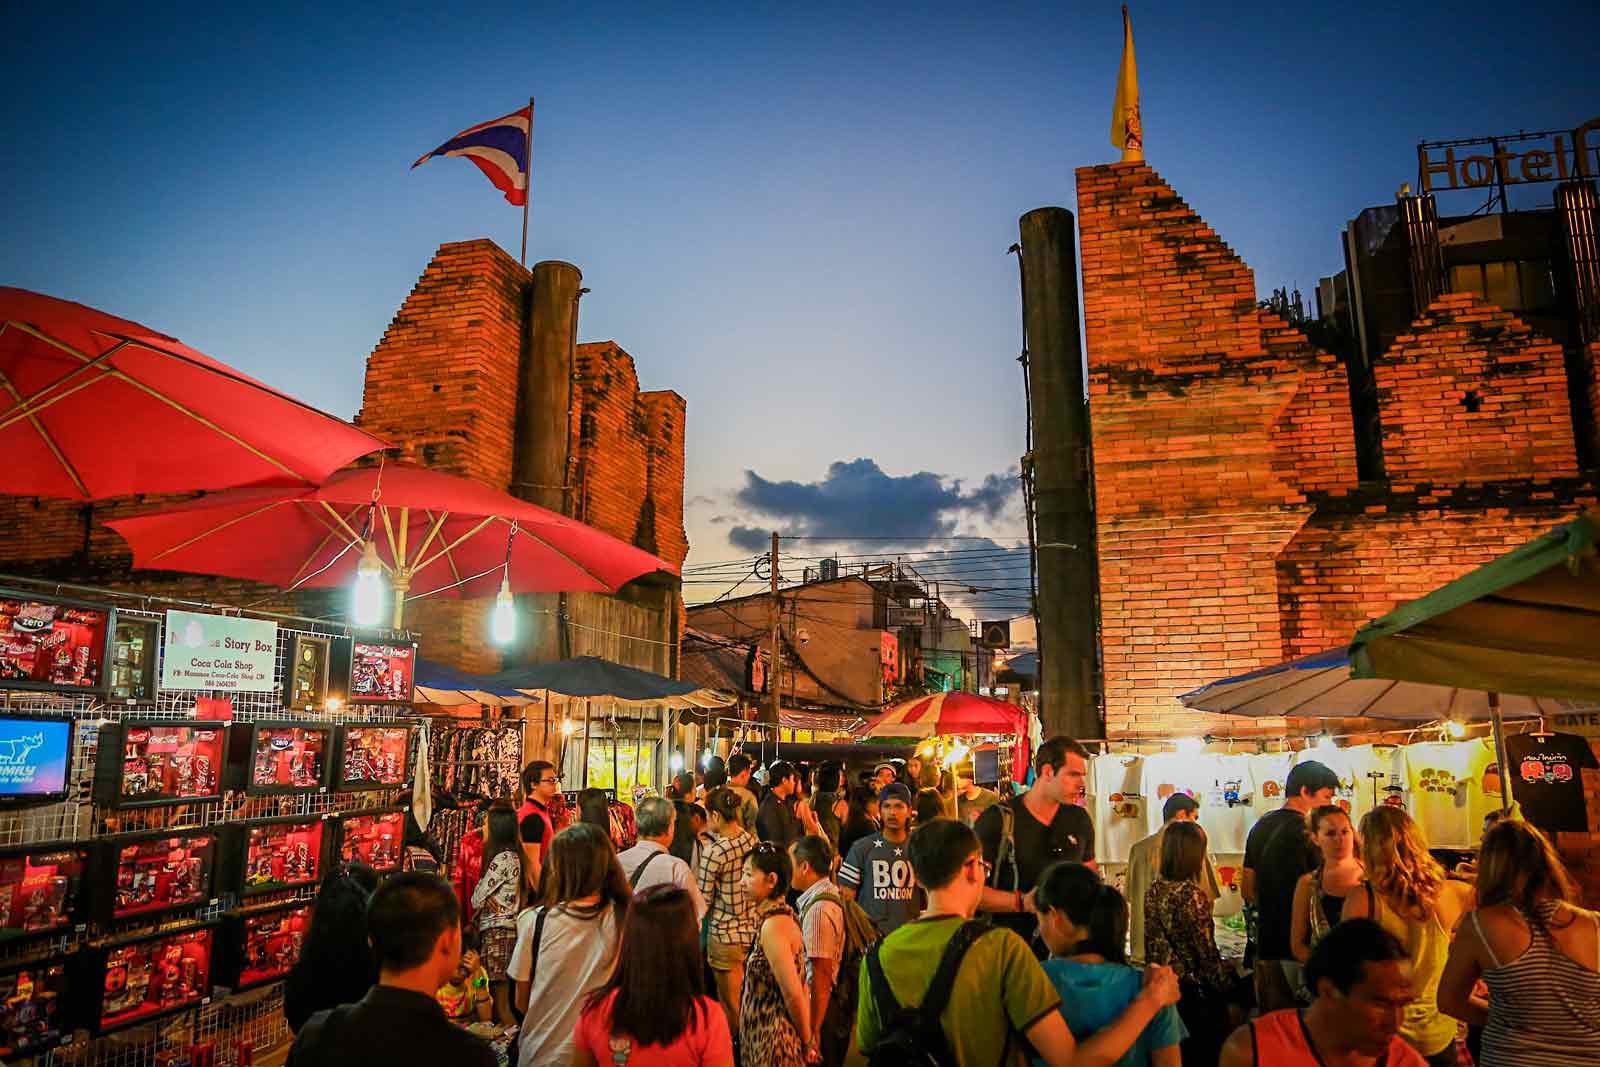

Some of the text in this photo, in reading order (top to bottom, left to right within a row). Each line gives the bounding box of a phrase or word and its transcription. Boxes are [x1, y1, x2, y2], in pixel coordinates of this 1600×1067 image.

[1420, 135, 1568, 191] Hotel
[22, 618, 44, 627] zero
[224, 637, 251, 653] Story
[255, 639, 273, 652] Box
[191, 658, 254, 671] Coca Cola Shop
[874, 887, 913, 900] LONDON
